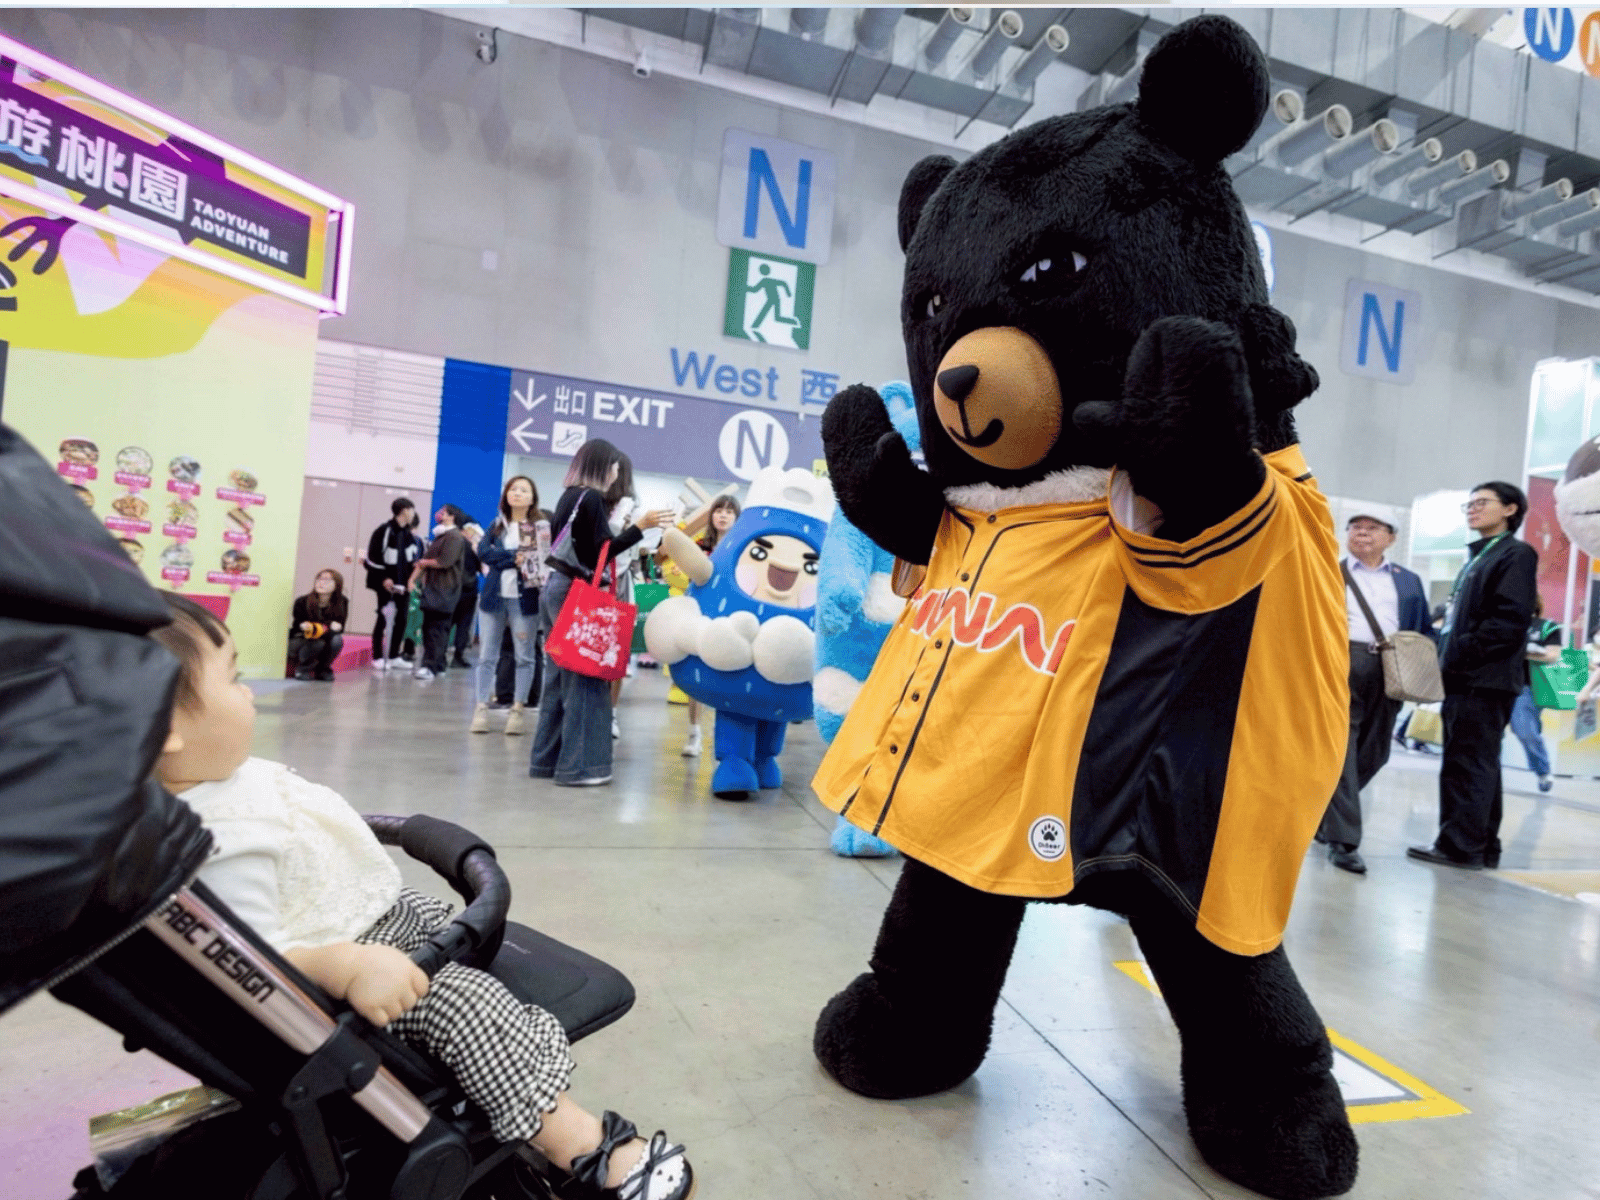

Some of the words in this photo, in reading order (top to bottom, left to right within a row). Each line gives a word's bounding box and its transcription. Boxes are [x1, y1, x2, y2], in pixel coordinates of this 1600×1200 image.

[1534, 8, 1563, 52] N
[192, 198, 270, 240] TAOYUAN
[743, 146, 813, 249] N
[190, 215, 289, 264] ADVENTURE
[1356, 292, 1405, 373] N
[670, 347, 779, 401] West
[801, 369, 841, 405] 西
[553, 385, 586, 416] 出口
[593, 391, 674, 428] EXIT
[735, 419, 773, 470] N
[161, 902, 212, 946] ABC
[201, 936, 277, 1003] DESIGN
